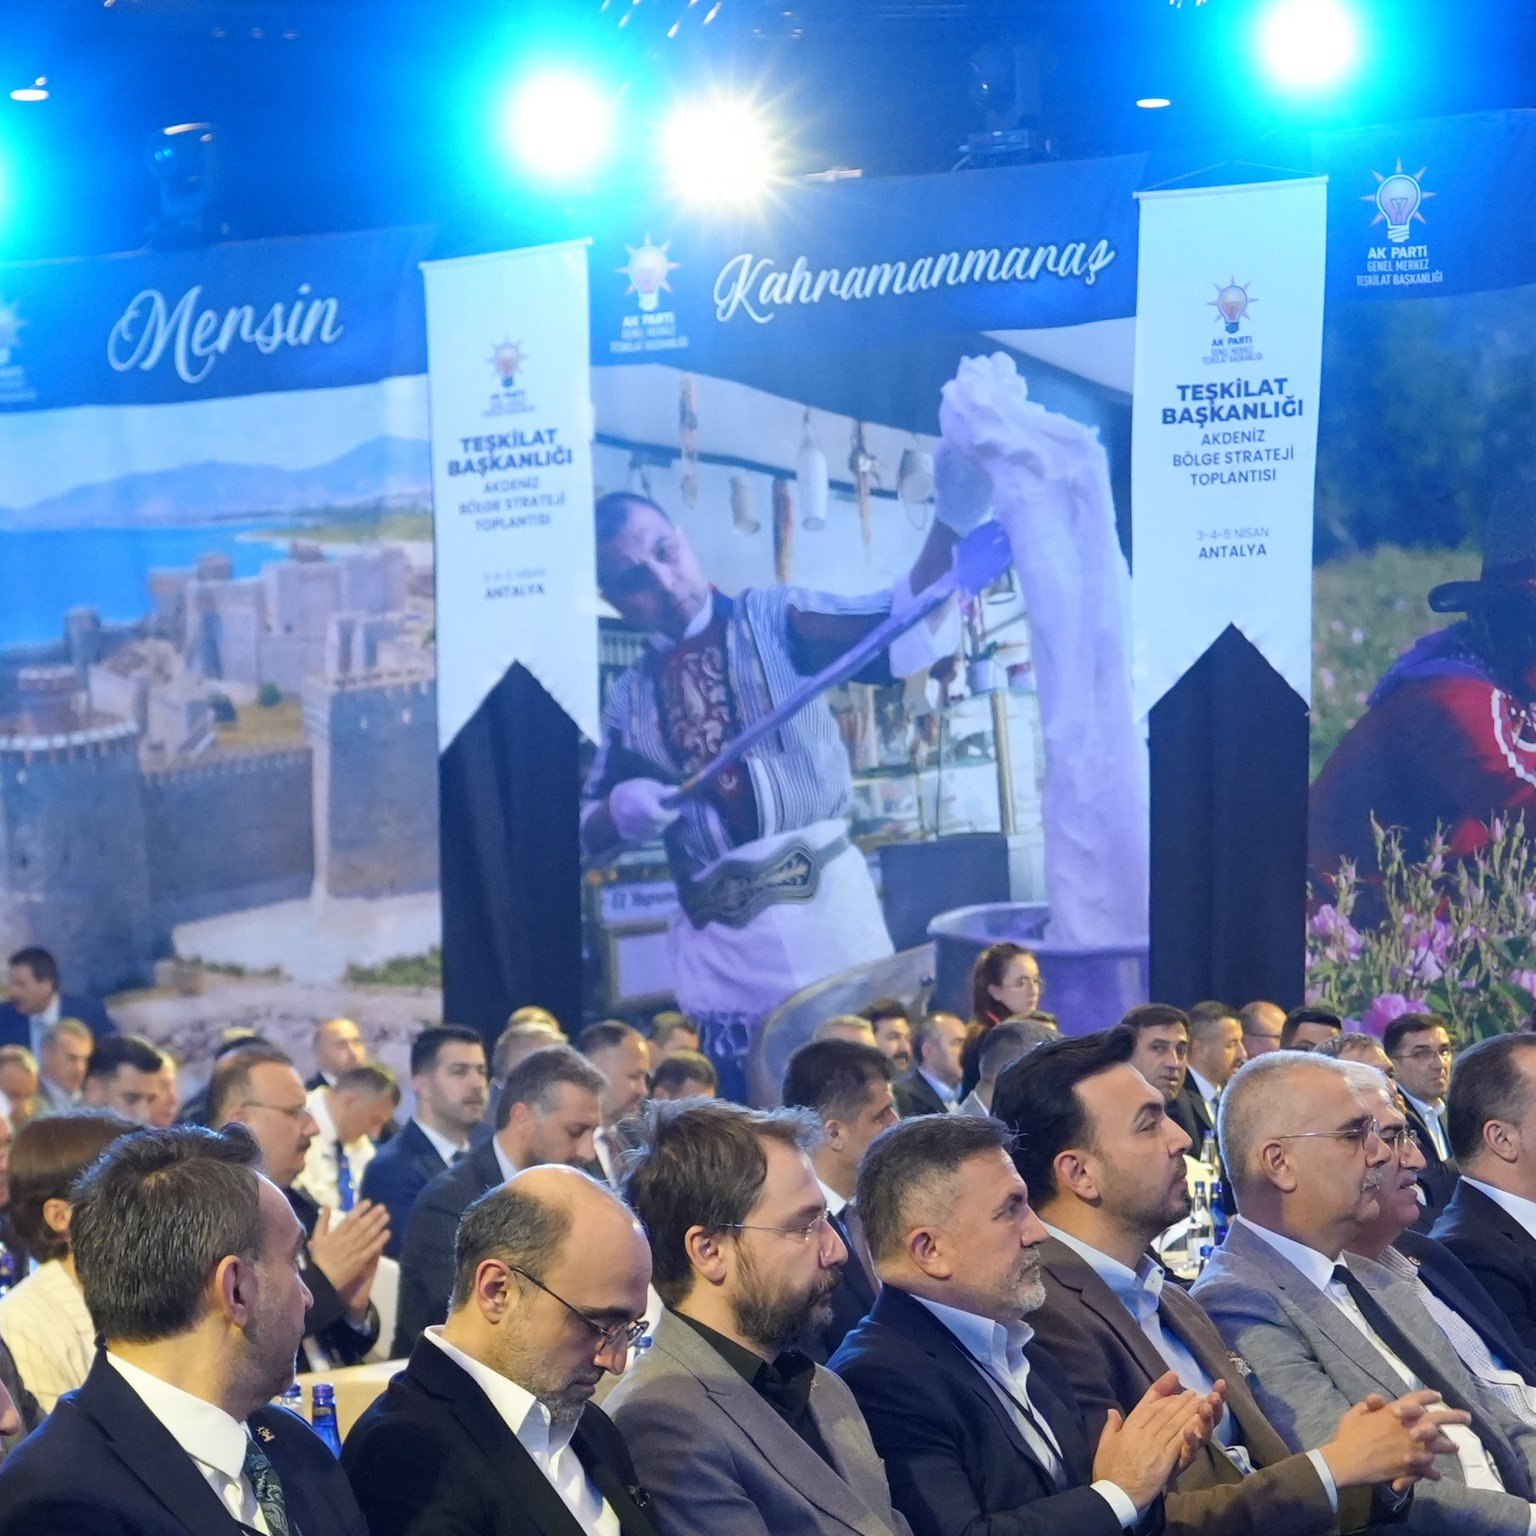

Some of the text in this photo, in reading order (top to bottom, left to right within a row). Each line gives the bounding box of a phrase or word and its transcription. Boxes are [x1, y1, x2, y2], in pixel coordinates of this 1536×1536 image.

[1367, 247, 1386, 259] AK
[714, 237, 1116, 323] Kahramanmaraş
[108, 283, 346, 384] Mersin
[1176, 377, 1288, 404] TEŞKİLAT
[1162, 394, 1303, 428] BAŞKANLIĞI
[461, 428, 558, 453] TEŞKİLAT
[1201, 426, 1266, 446] AKDENİZ
[448, 444, 573, 477] BAŞKANLIĞI
[1173, 444, 1294, 467] BÖLGE STRATEJİ
[1190, 469, 1277, 486] TOPLANTISI
[1199, 544, 1267, 559] ANTALYA
[485, 584, 544, 599] ANTALYA
